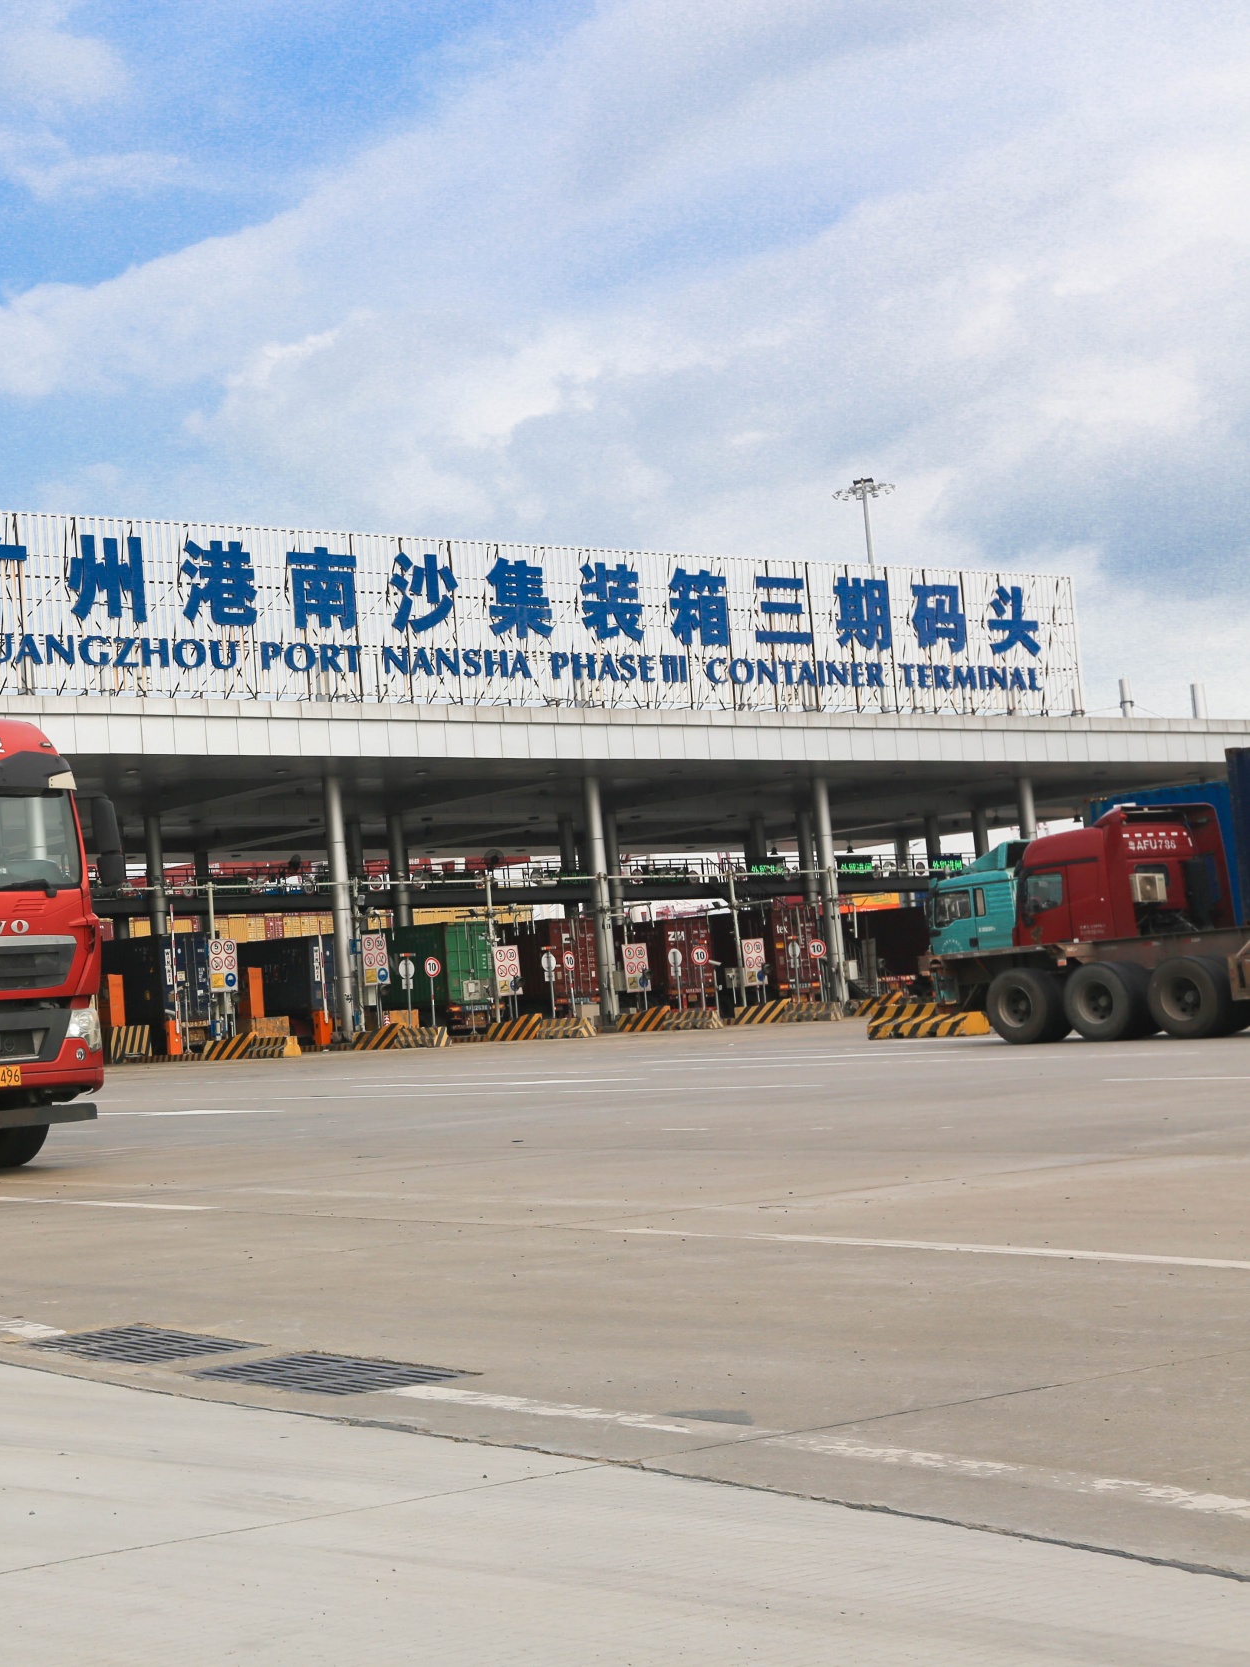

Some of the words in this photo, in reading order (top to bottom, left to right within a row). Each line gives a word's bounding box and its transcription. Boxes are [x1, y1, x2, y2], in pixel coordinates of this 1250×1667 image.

[261, 641, 362, 675] PORT
[383, 647, 532, 680] NANSHA
[706, 657, 884, 688] CONTAINER
[899, 663, 1043, 692] TERMINAL
[776, 924, 789, 934] tex
[811, 944, 822, 953] 10
[694, 951, 705, 960] 10
[565, 956, 574, 965] 10
[427, 962, 436, 972] 10
